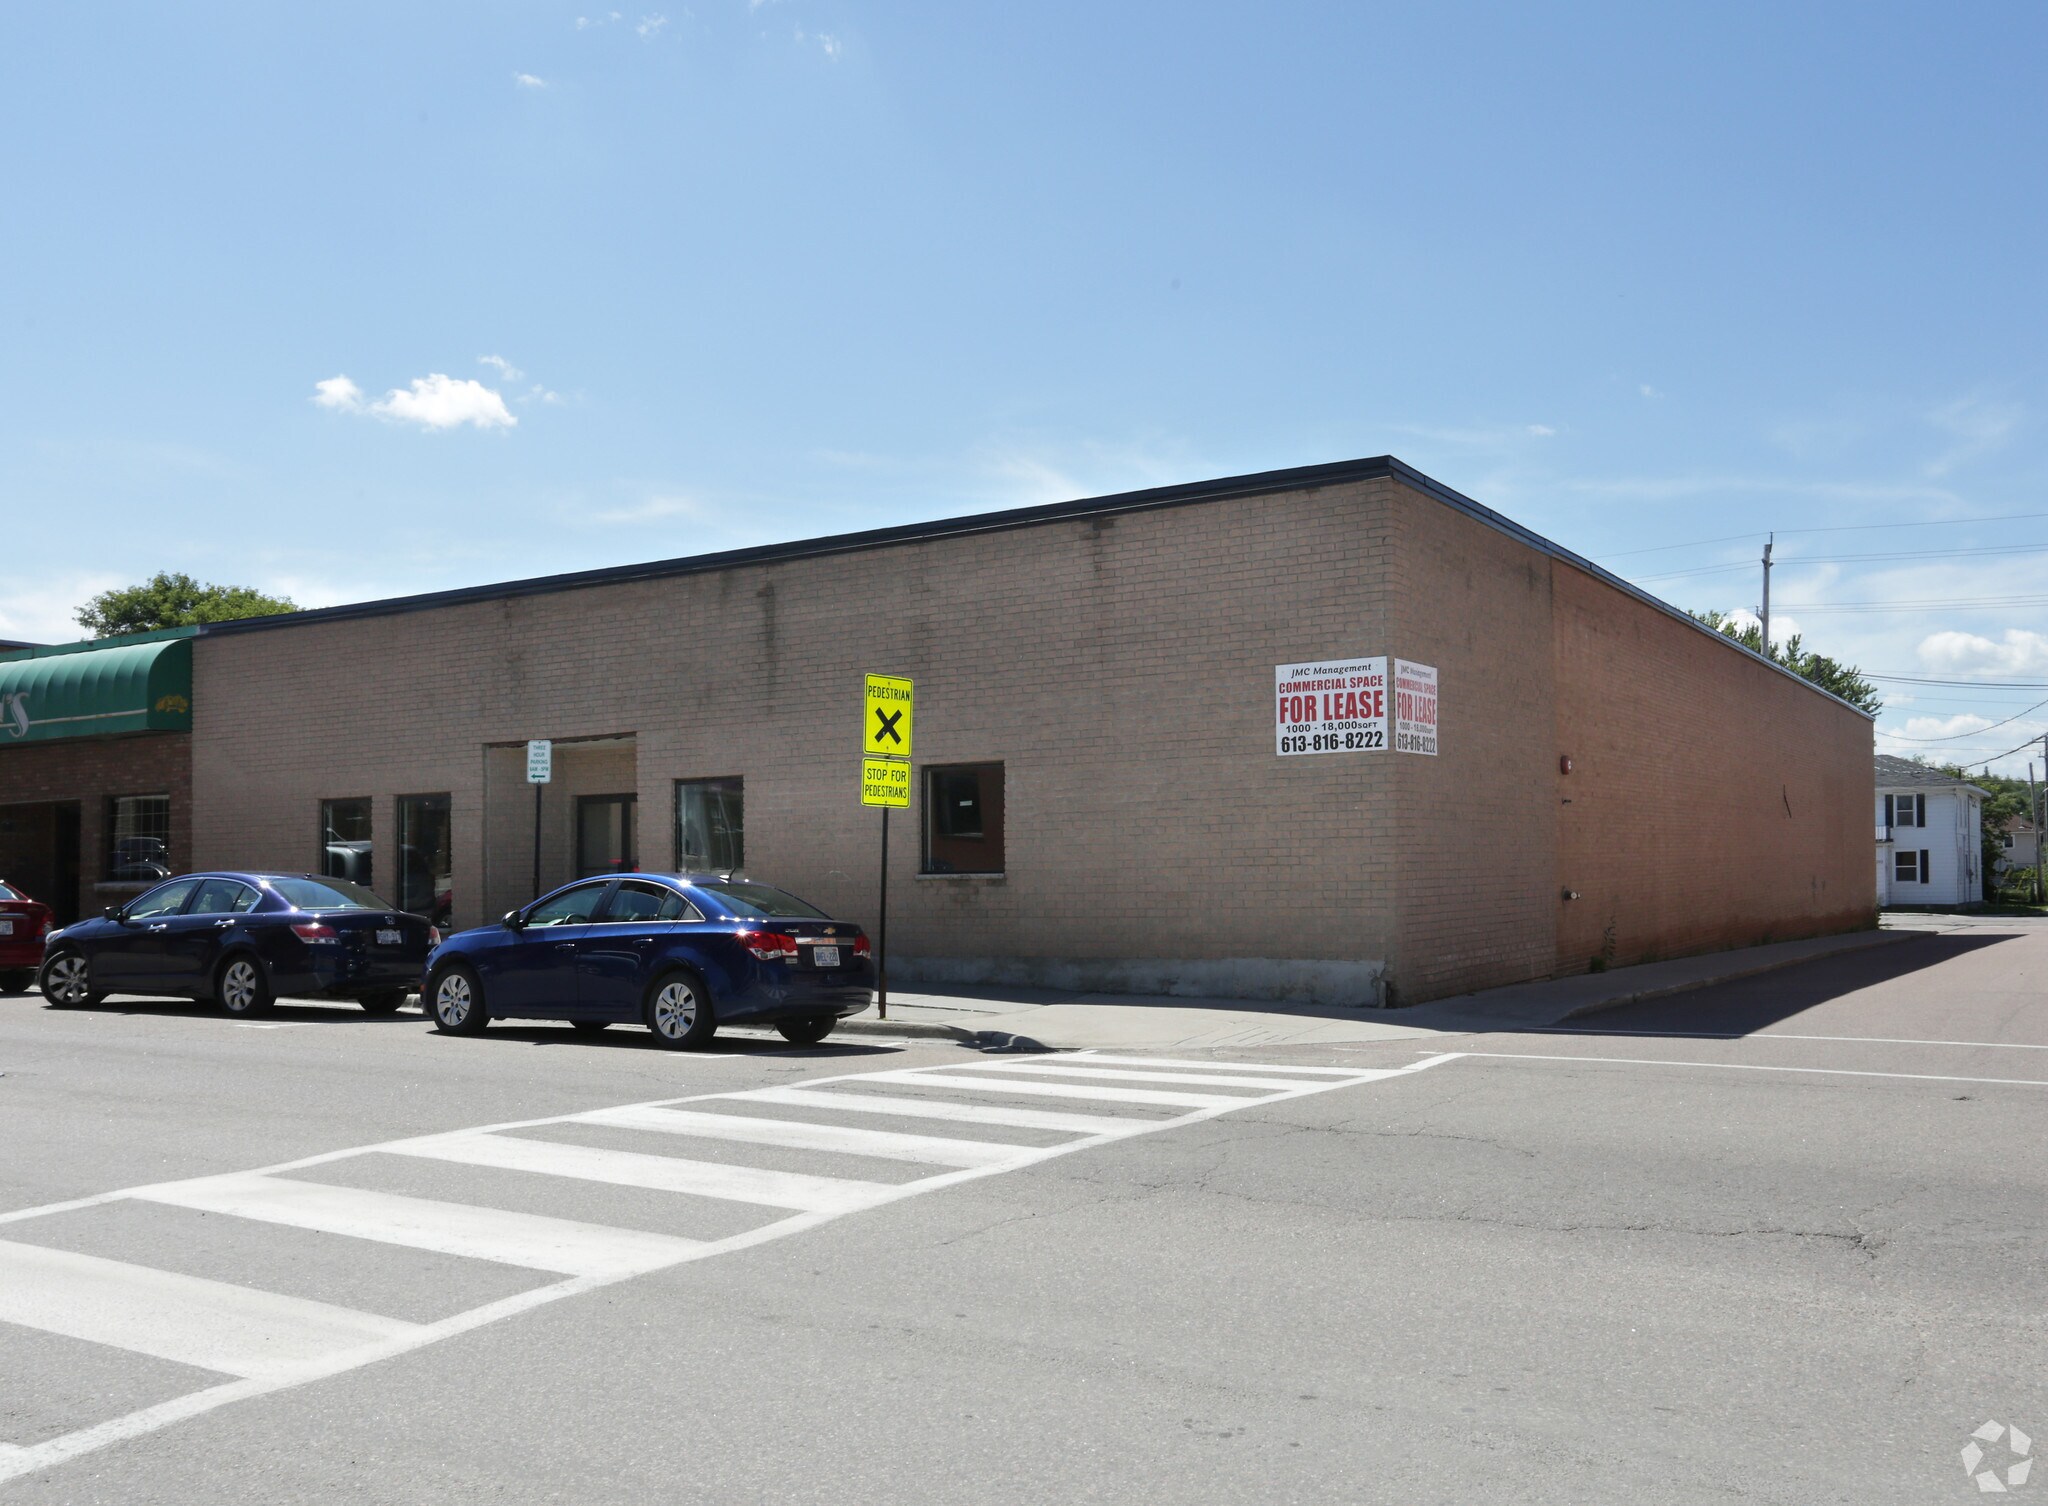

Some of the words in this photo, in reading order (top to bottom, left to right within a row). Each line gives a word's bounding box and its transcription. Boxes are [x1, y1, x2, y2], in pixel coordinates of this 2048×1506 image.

[1291, 667, 1310, 679] JMC
[1313, 663, 1372, 675] Management
[868, 685, 910, 702] PEDESTRIAN
[1279, 678, 1347, 694] COMMERCIAL
[1350, 675, 1383, 689] SPACE
[1396, 676, 1423, 693] COMMERCIAL
[1424, 682, 1436, 696] SPACE
[1279, 694, 1317, 724] FOR
[1323, 690, 1384, 721] LEASE
[1397, 692, 1413, 721] FOR
[1415, 695, 1436, 725] LEASE
[1286, 724, 1311, 734] 1000
[1281, 731, 1383, 753] 613-816-8222
[1397, 732, 1436, 753] 613-816-8222
[867, 768, 888, 781] STOP
[891, 769, 907, 783] FOR
[865, 784, 907, 799] PEDESTRIANS
